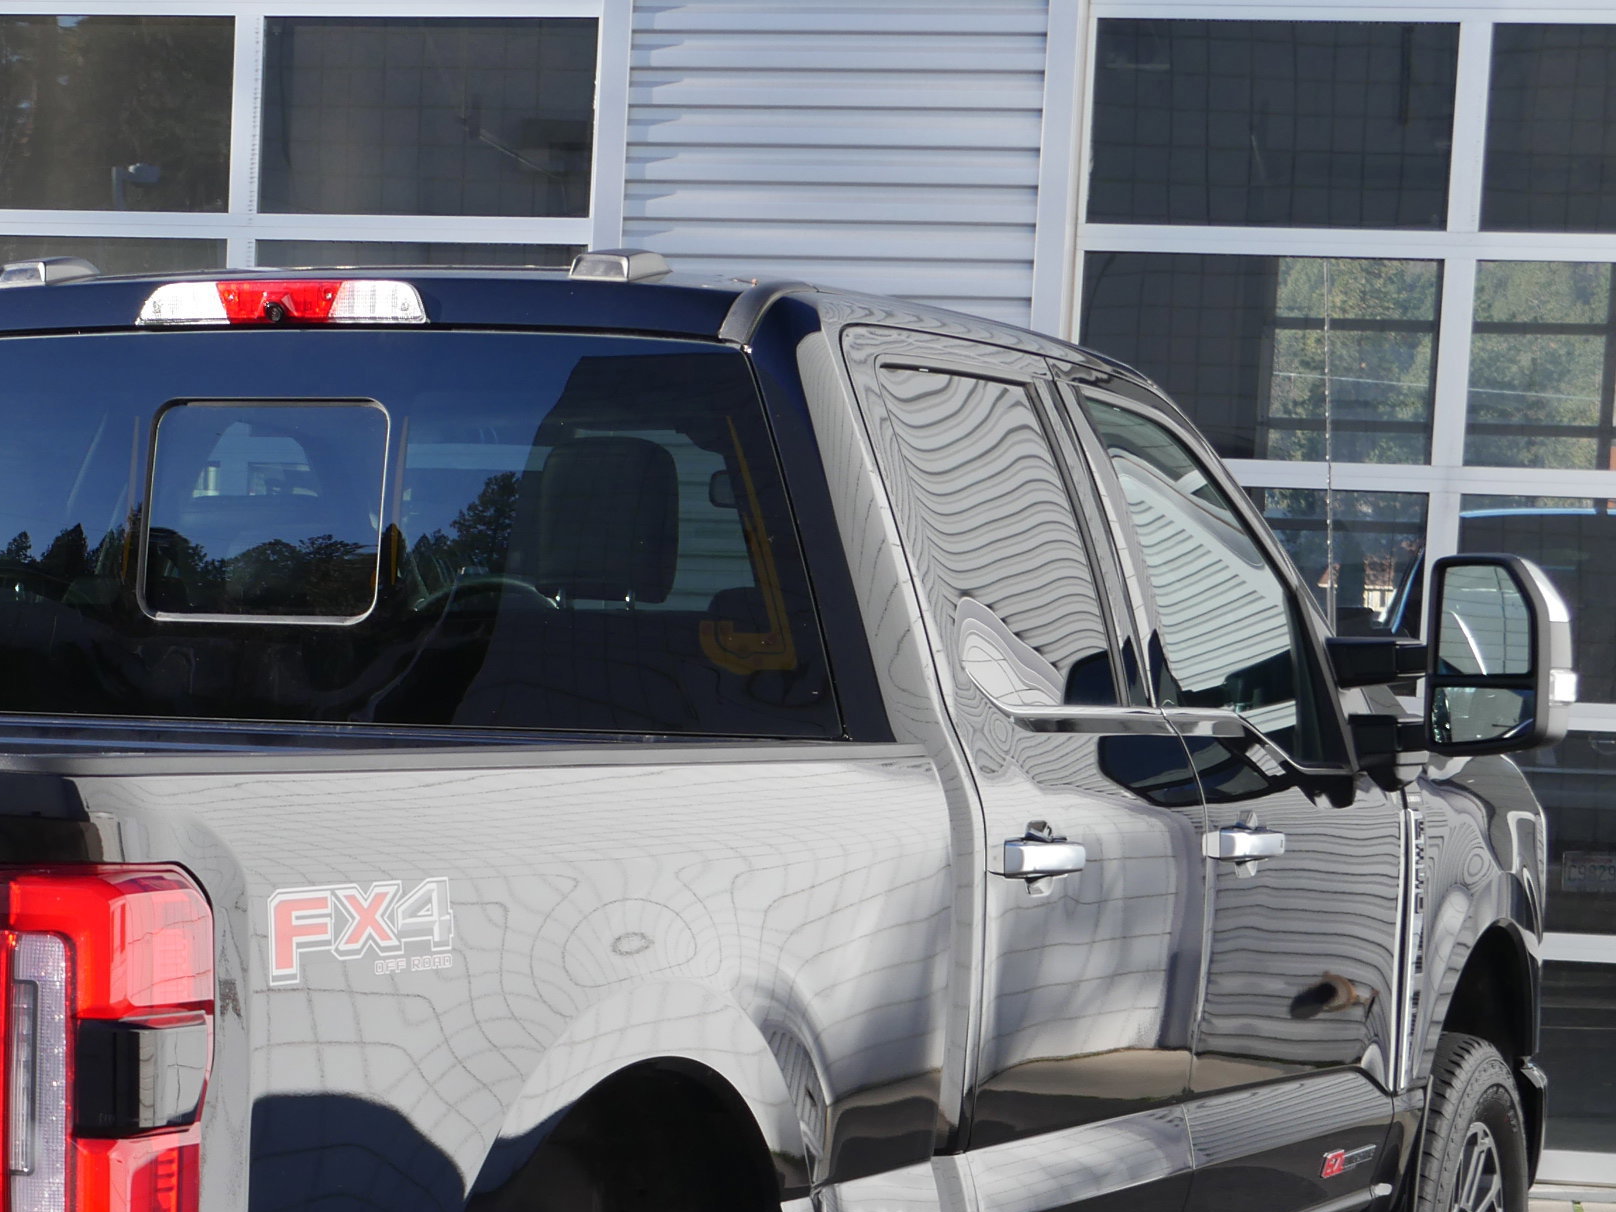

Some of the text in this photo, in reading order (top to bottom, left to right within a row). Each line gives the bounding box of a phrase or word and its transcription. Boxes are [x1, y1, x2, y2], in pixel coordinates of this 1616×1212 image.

[267, 877, 453, 986] FX4
[374, 952, 453, 975] OFF ROAD
